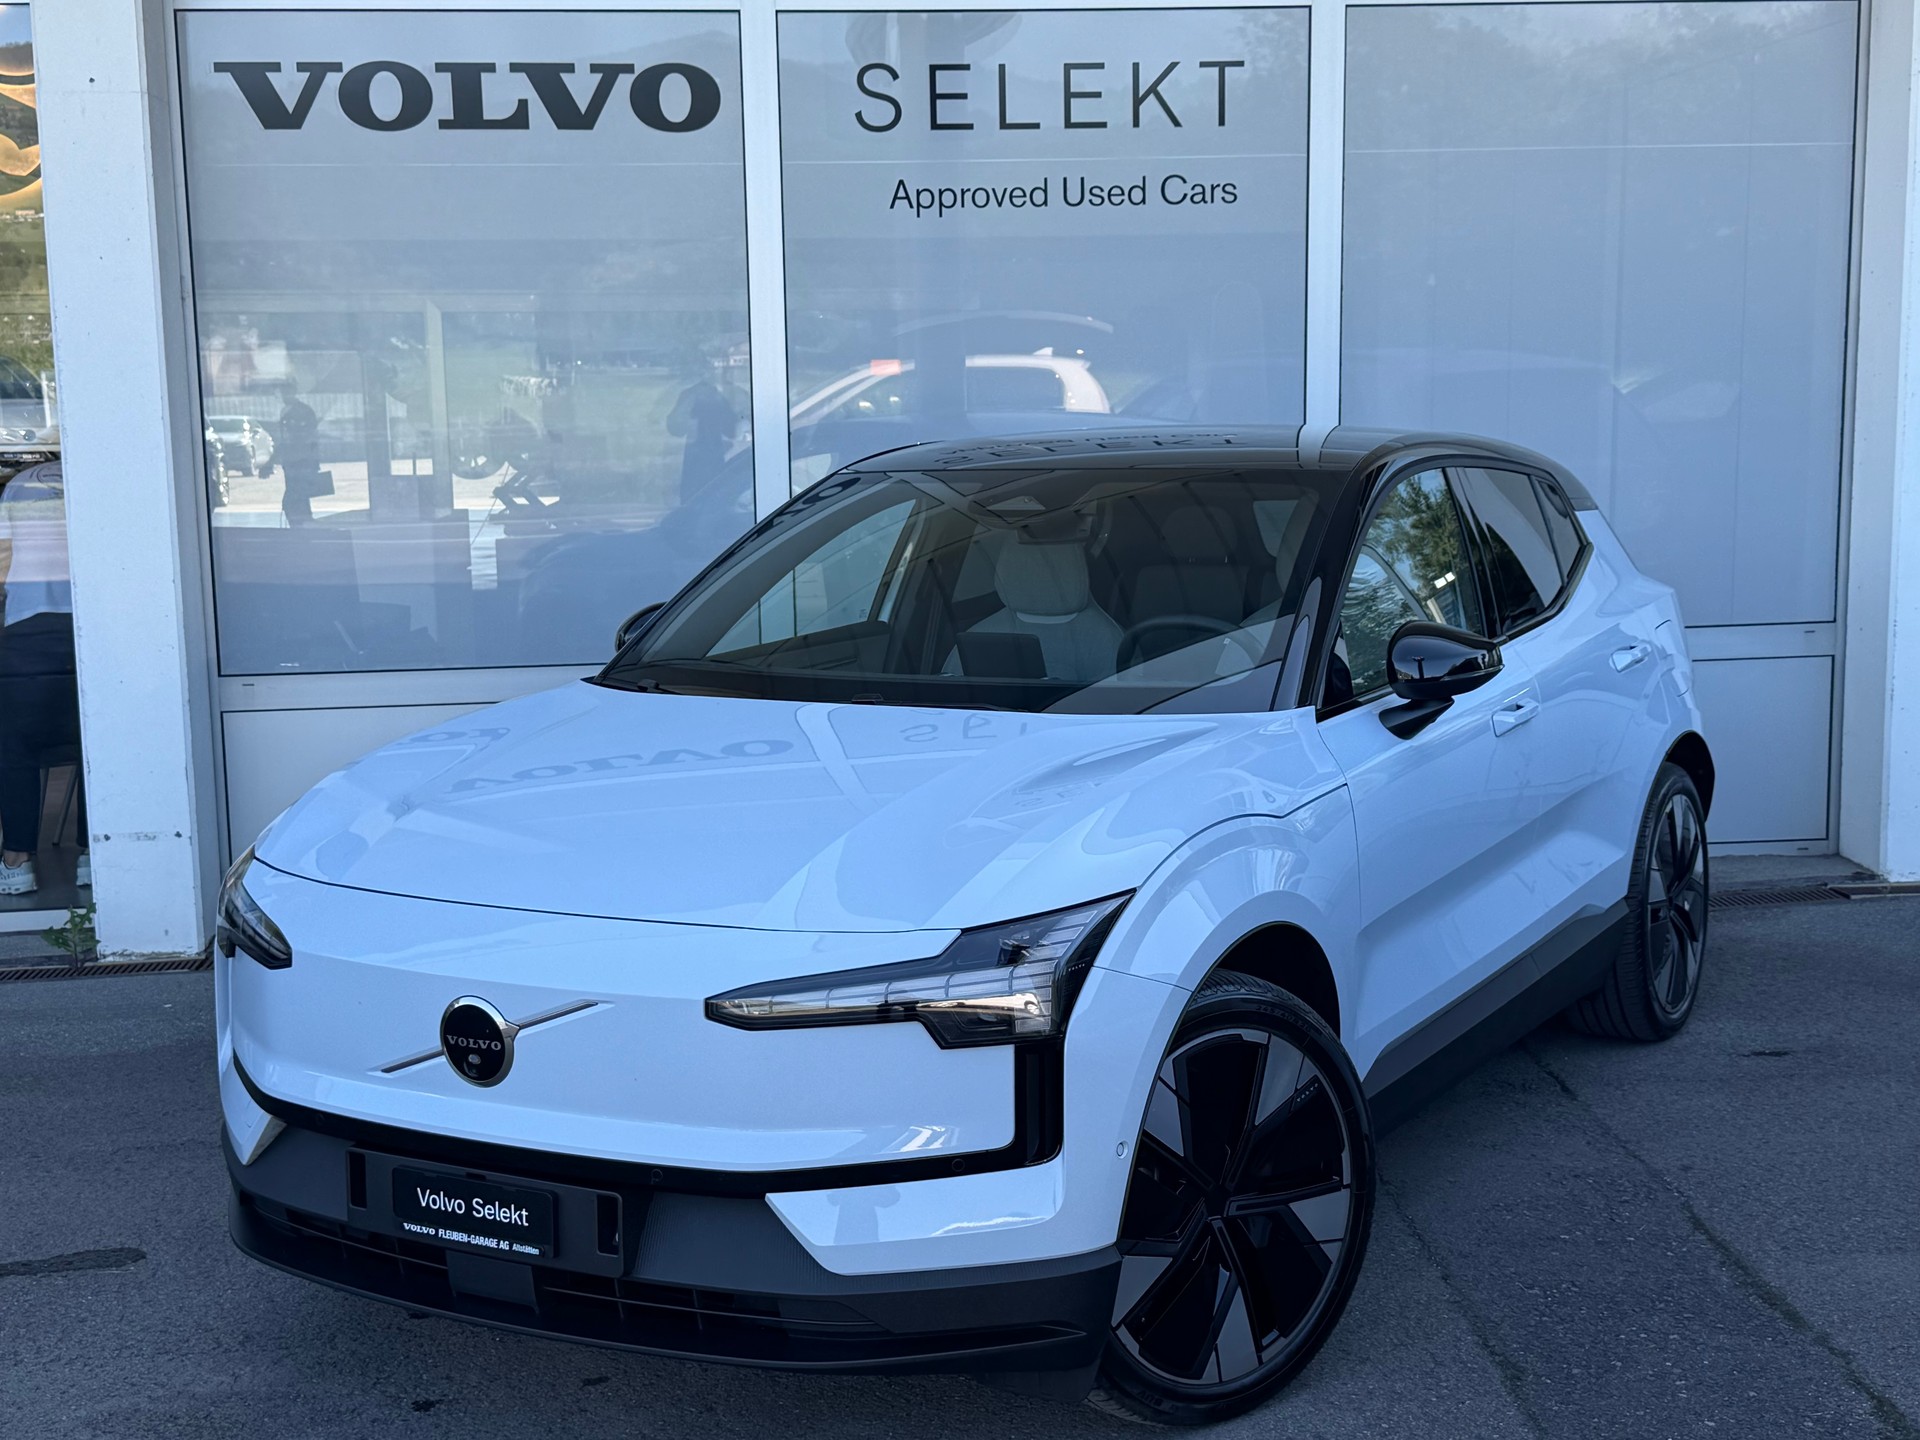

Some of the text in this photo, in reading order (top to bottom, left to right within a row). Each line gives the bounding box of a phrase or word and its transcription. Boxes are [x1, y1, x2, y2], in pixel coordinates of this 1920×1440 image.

[214, 61, 721, 132] VOLVO
[855, 61, 1245, 132] SELEKT
[889, 175, 1238, 218] Approved Used Cars
[446, 1035, 502, 1051] VOLVO
[416, 1187, 529, 1227] Volvo Selekt
[403, 1222, 436, 1235] VOLVO
[438, 1228, 499, 1248] FLEUBEN-GARAGE
[499, 1239, 510, 1250] AG
